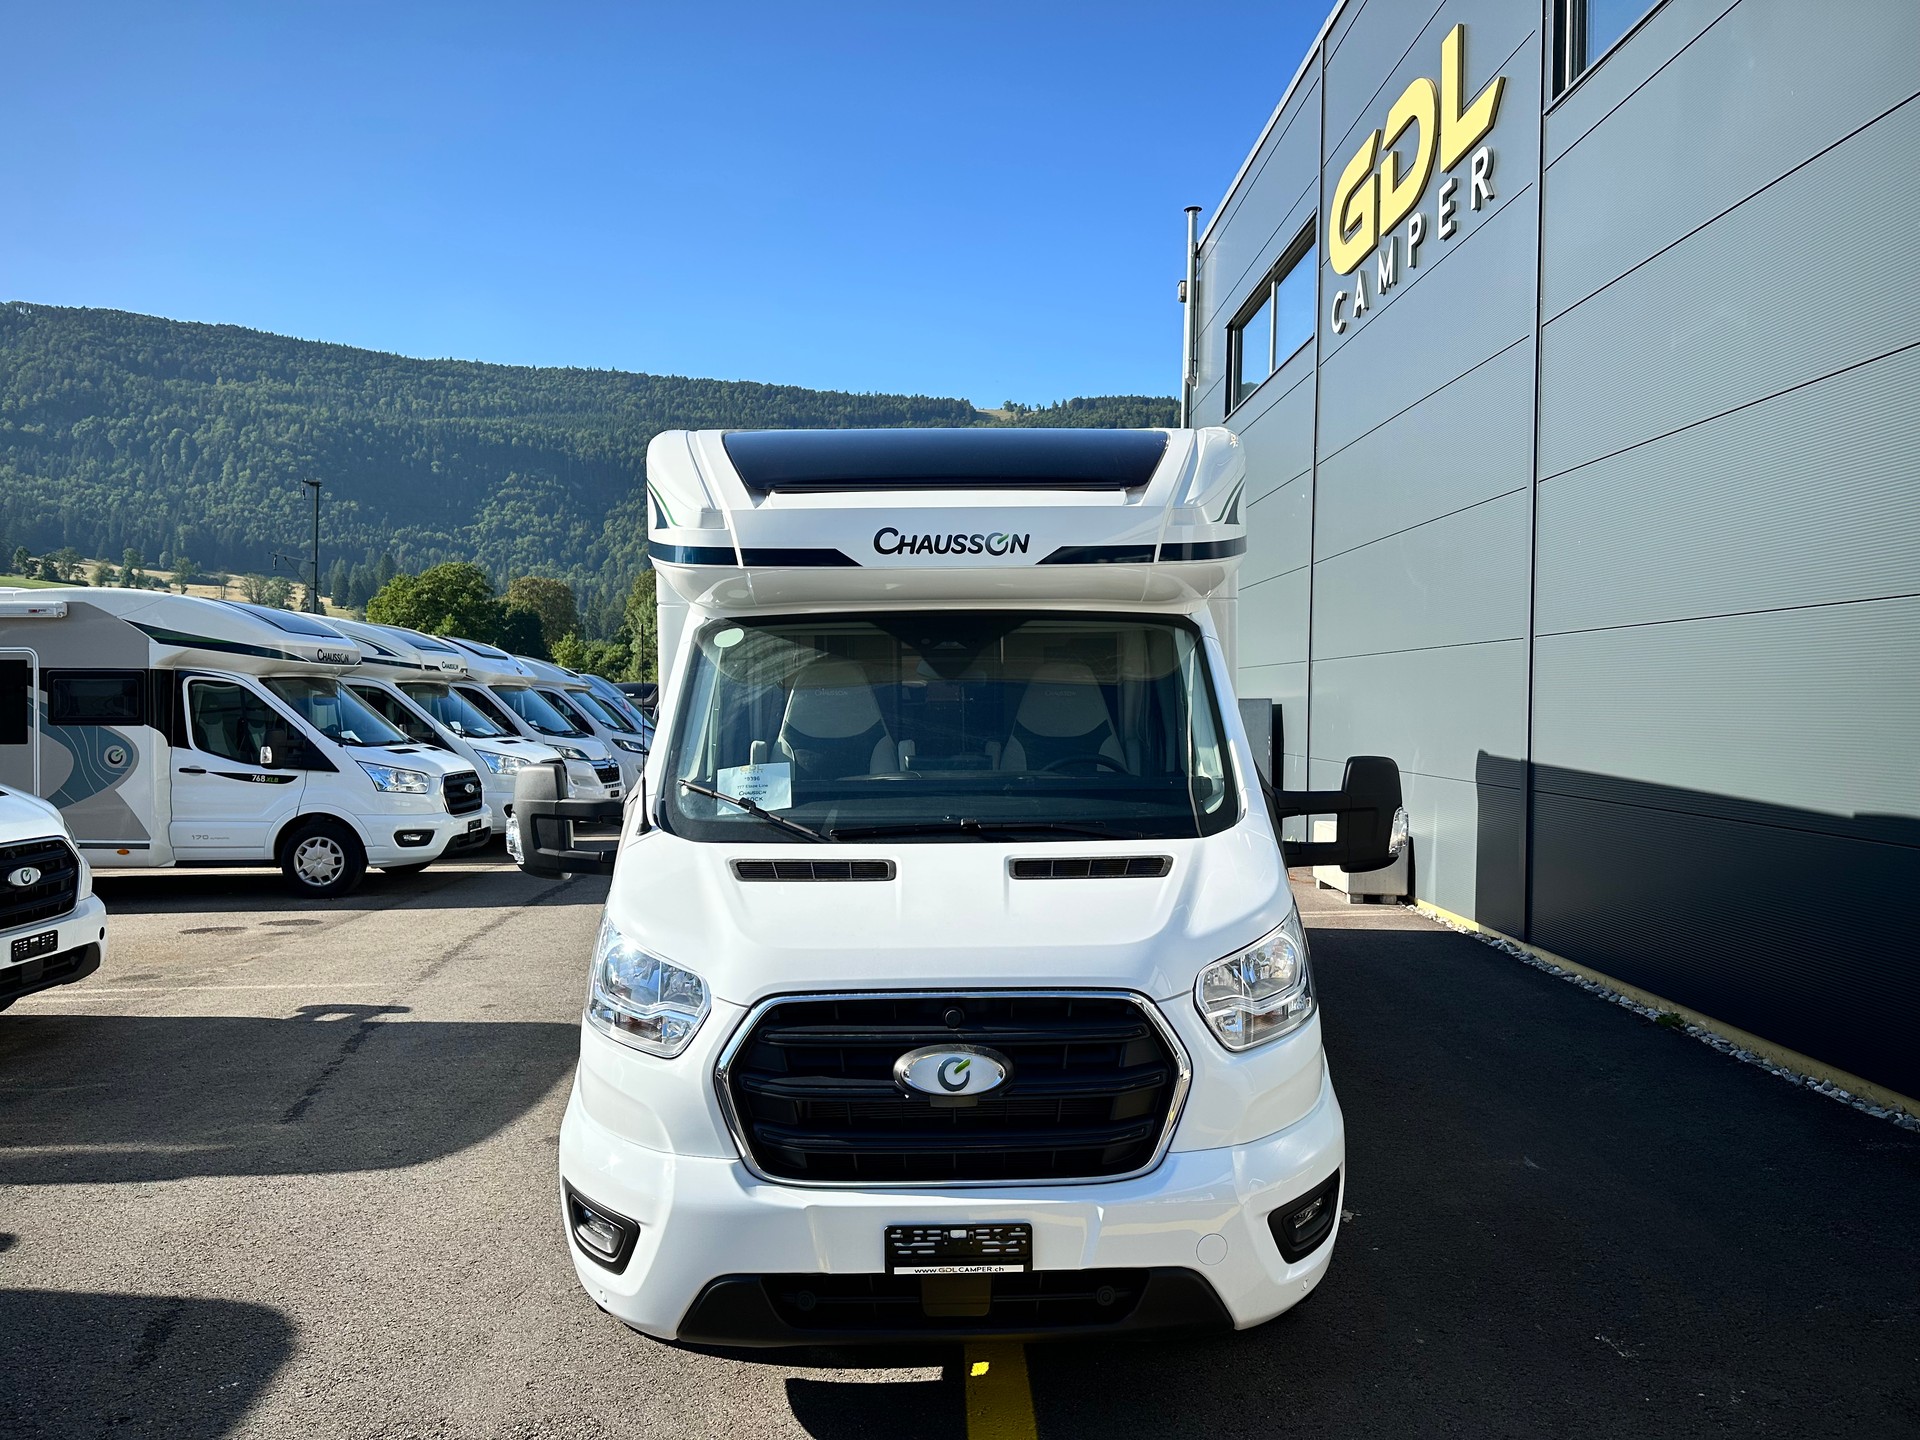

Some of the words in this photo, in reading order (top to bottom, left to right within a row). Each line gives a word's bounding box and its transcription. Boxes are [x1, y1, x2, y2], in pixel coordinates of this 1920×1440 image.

[1329, 23, 1505, 275] GDL
[1331, 146, 1495, 334] CAMPER
[873, 526, 1030, 556] CHAUSSON
[316, 648, 350, 664] CHAUSSON
[252, 774, 266, 783] 768
